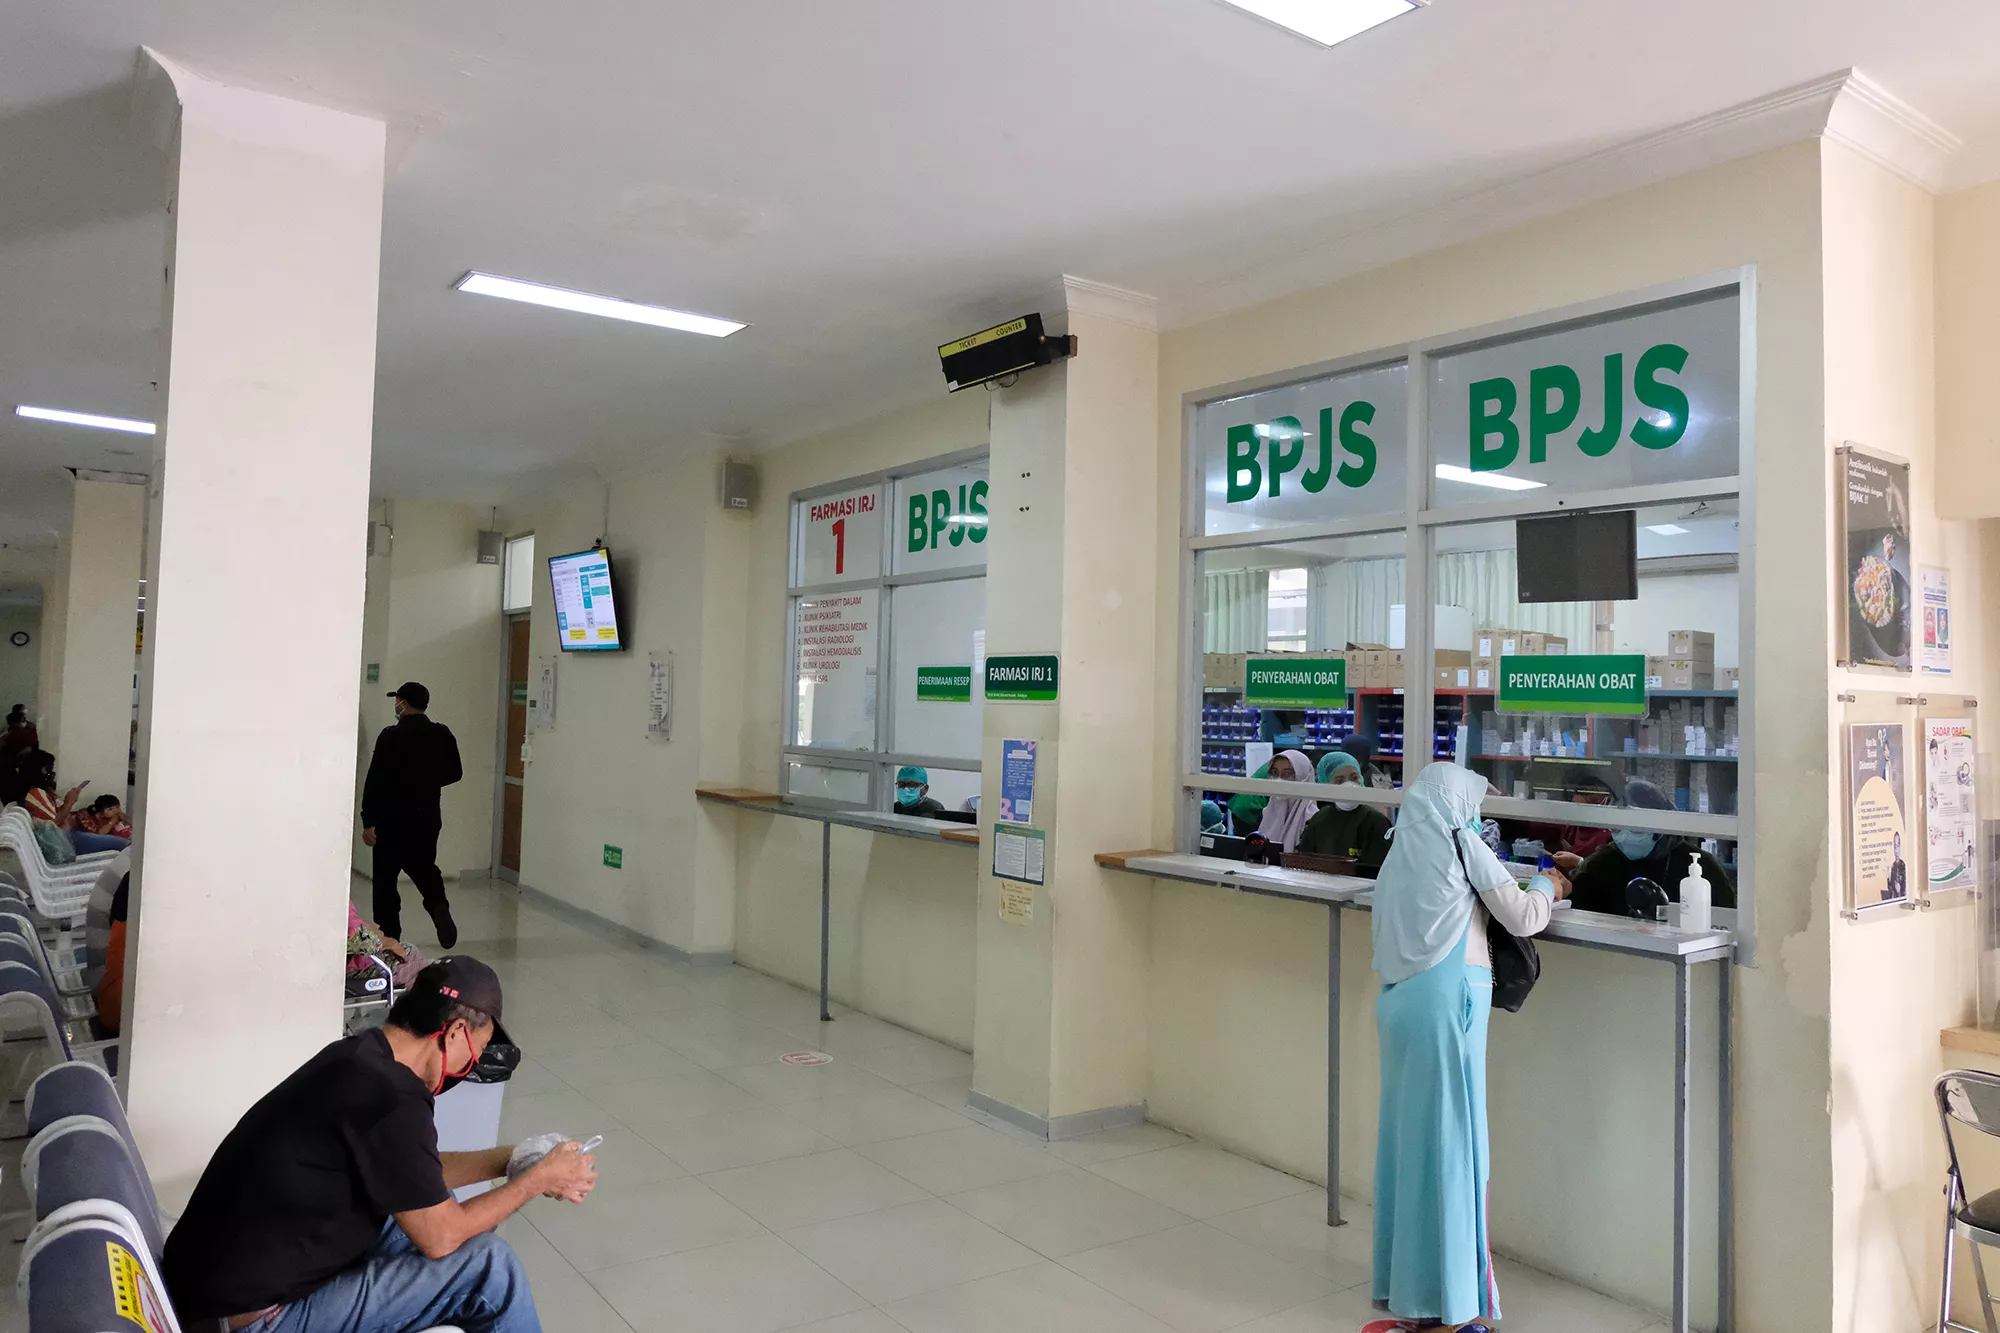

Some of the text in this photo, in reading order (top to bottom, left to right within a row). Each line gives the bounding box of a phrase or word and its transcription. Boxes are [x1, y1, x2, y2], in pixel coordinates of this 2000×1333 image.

[959, 321, 1023, 349] TICKET COUNTER
[1468, 343, 1691, 473] BPJS
[1227, 400, 1378, 503] BPJS
[811, 493, 875, 522] FARMASI IRJ
[908, 480, 989, 553] BPJS
[832, 518, 845, 575] 1
[820, 599, 842, 608] PENYAKIT
[843, 597, 861, 606] DALAM
[804, 613, 818, 621] KLINIK
[819, 611, 841, 620] PSIKIATRI
[804, 625, 818, 633] KLINIK
[819, 623, 850, 632] REHABILITASI
[851, 622, 868, 631] MEDIK
[804, 636, 826, 645] INSTALASI
[827, 634, 854, 644] RADIOLOGI
[803, 648, 826, 657] INSTALASI
[827, 647, 862, 656] HEMODIALISIS
[803, 661, 818, 669] KLINIK
[819, 661, 840, 669] UROLOGI
[989, 667, 1052, 681] FARMASI IRJ 1
[1251, 671, 1339, 685] PENYERAHAN OBAT
[918, 676, 970, 686] PENERIMAAN RESEP
[1508, 673, 1596, 689] PENYERAHAN
[1599, 673, 1637, 690] OBAT
[1932, 726, 1966, 737] SADAR OBAT
[368, 980, 384, 988] GEA
